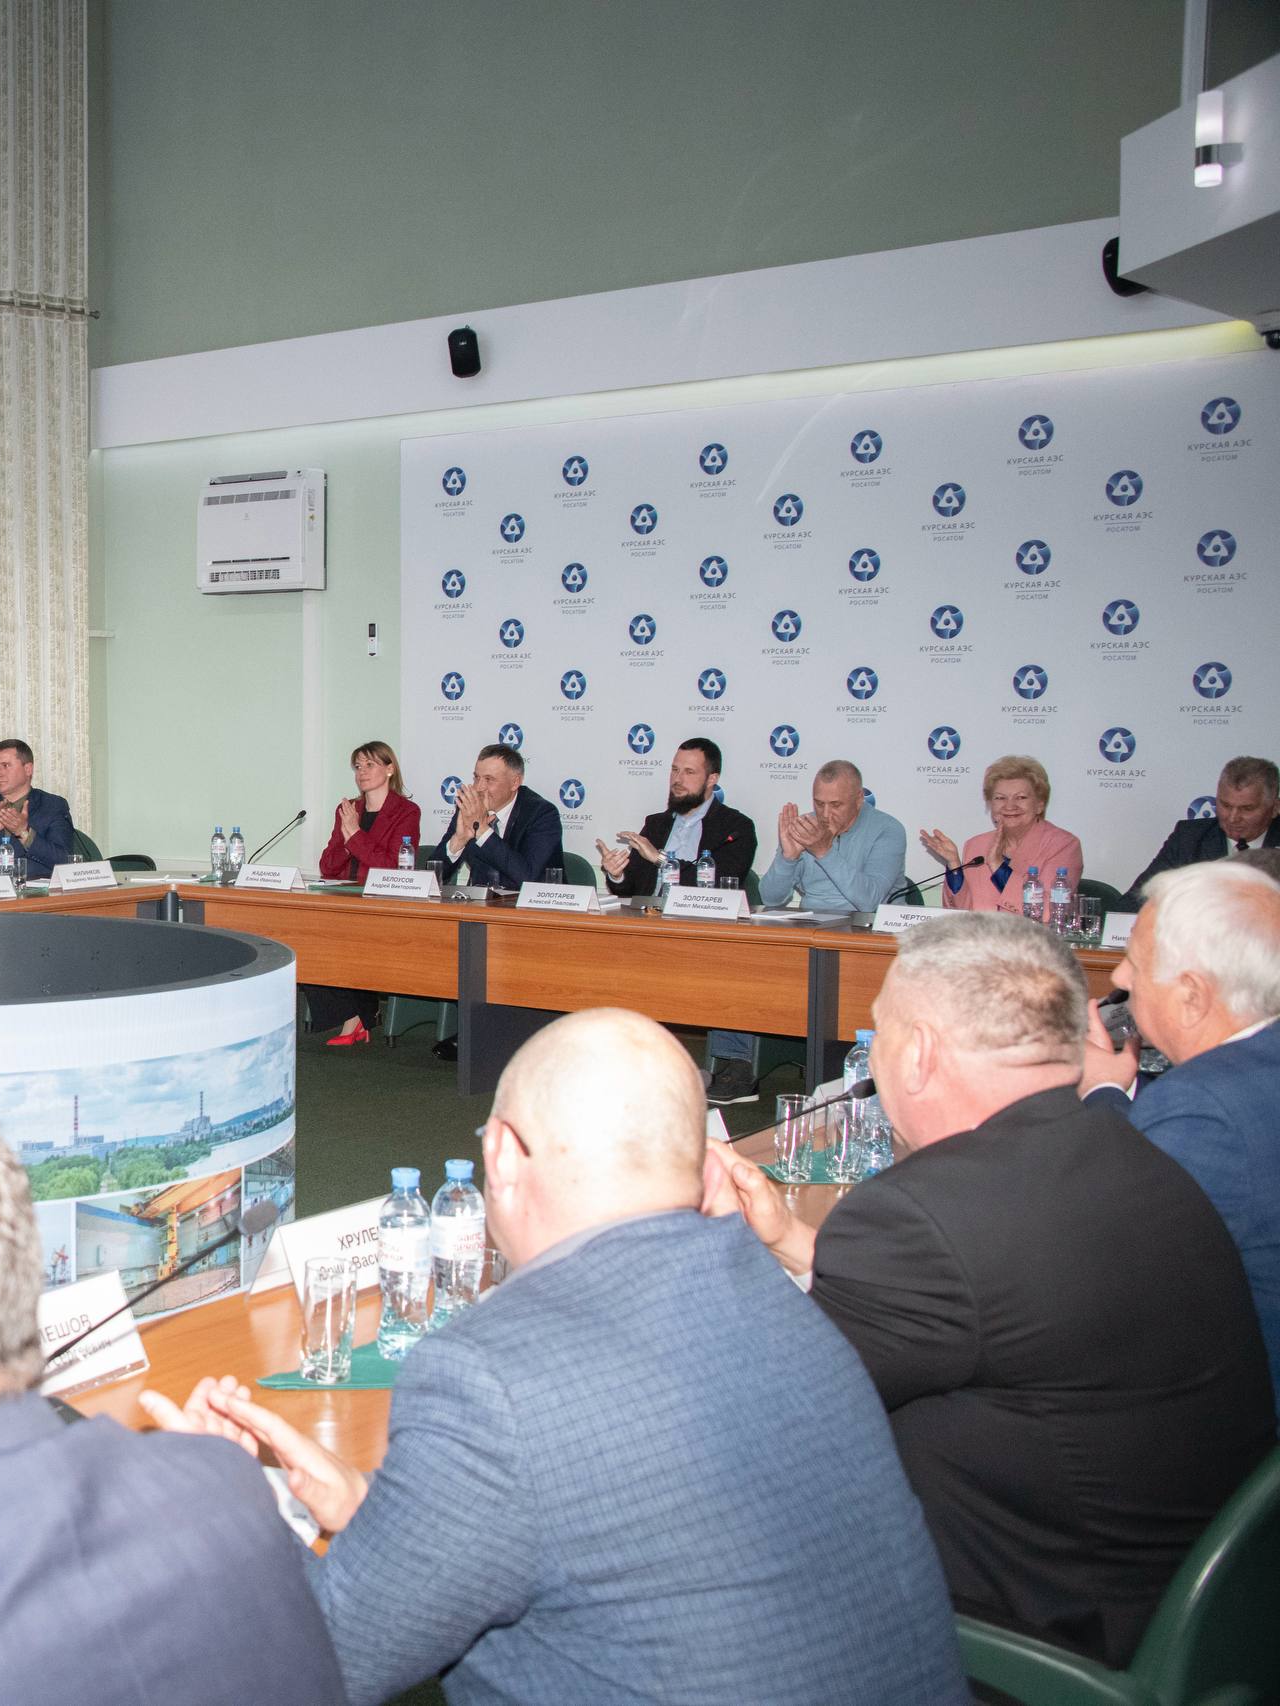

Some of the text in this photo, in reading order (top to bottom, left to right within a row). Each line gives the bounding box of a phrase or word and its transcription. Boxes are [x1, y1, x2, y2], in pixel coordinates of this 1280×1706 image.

[1187, 439, 1252, 450] КУРСКАЯ АЭС
[1007, 454, 1064, 464] КУРСКАЯ АЭС
[840, 467, 892, 477] КУРСКАЯ АЭС
[1093, 511, 1154, 521] КУРСКАЯ АЭС
[922, 522, 958, 531] КУРСКАЯ
[1184, 572, 1248, 582] КУРСКАЯ АЭС
[1004, 580, 1061, 589] КУРСКАЯ АЭС
[838, 586, 890, 595] КУРСКАЯ АЭС
[957, 644, 973, 652] АЭС
[1132, 641, 1150, 649] АЭС
[871, 705, 888, 713] АЭС
[1001, 705, 1058, 713] КУРСКАЯ АЭС
[1180, 705, 1243, 713] КУРСКАЯ АЭС
[954, 766, 971, 774] АЭС
[1128, 769, 1147, 777] АЭС
[537, 891, 575, 899] ЗОЛОТАРЕВ
[683, 894, 723, 903] ЗОЛОТАРЕВ
[337, 1226, 379, 1251] ХРУЛЕ
[352, 1252, 380, 1271] Васи
